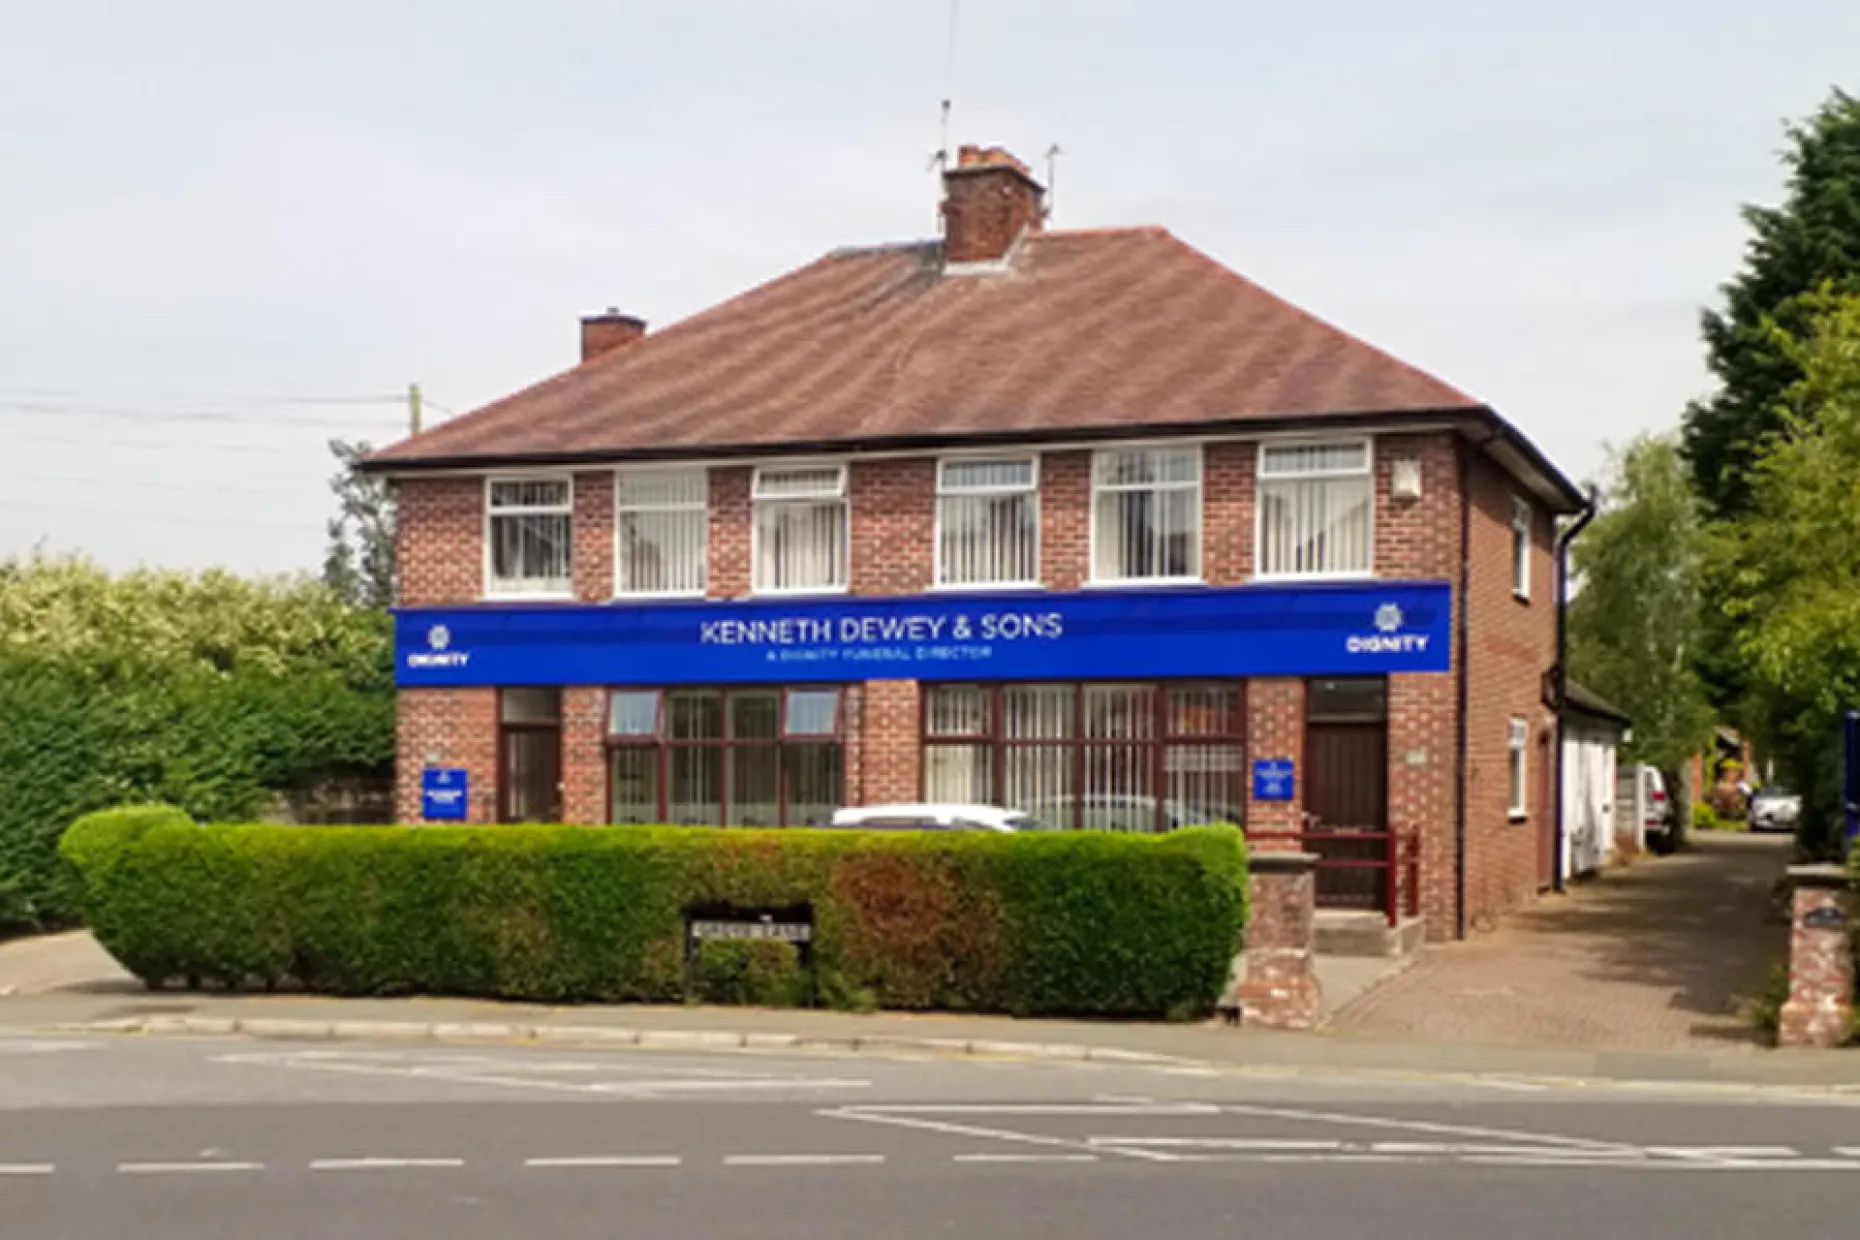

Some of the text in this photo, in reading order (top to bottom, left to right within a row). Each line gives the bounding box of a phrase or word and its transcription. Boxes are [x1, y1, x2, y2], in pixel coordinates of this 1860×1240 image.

[700, 611, 1063, 645] KENNETH DEWEY & SONS
[1345, 635, 1429, 653] DIGNITY
